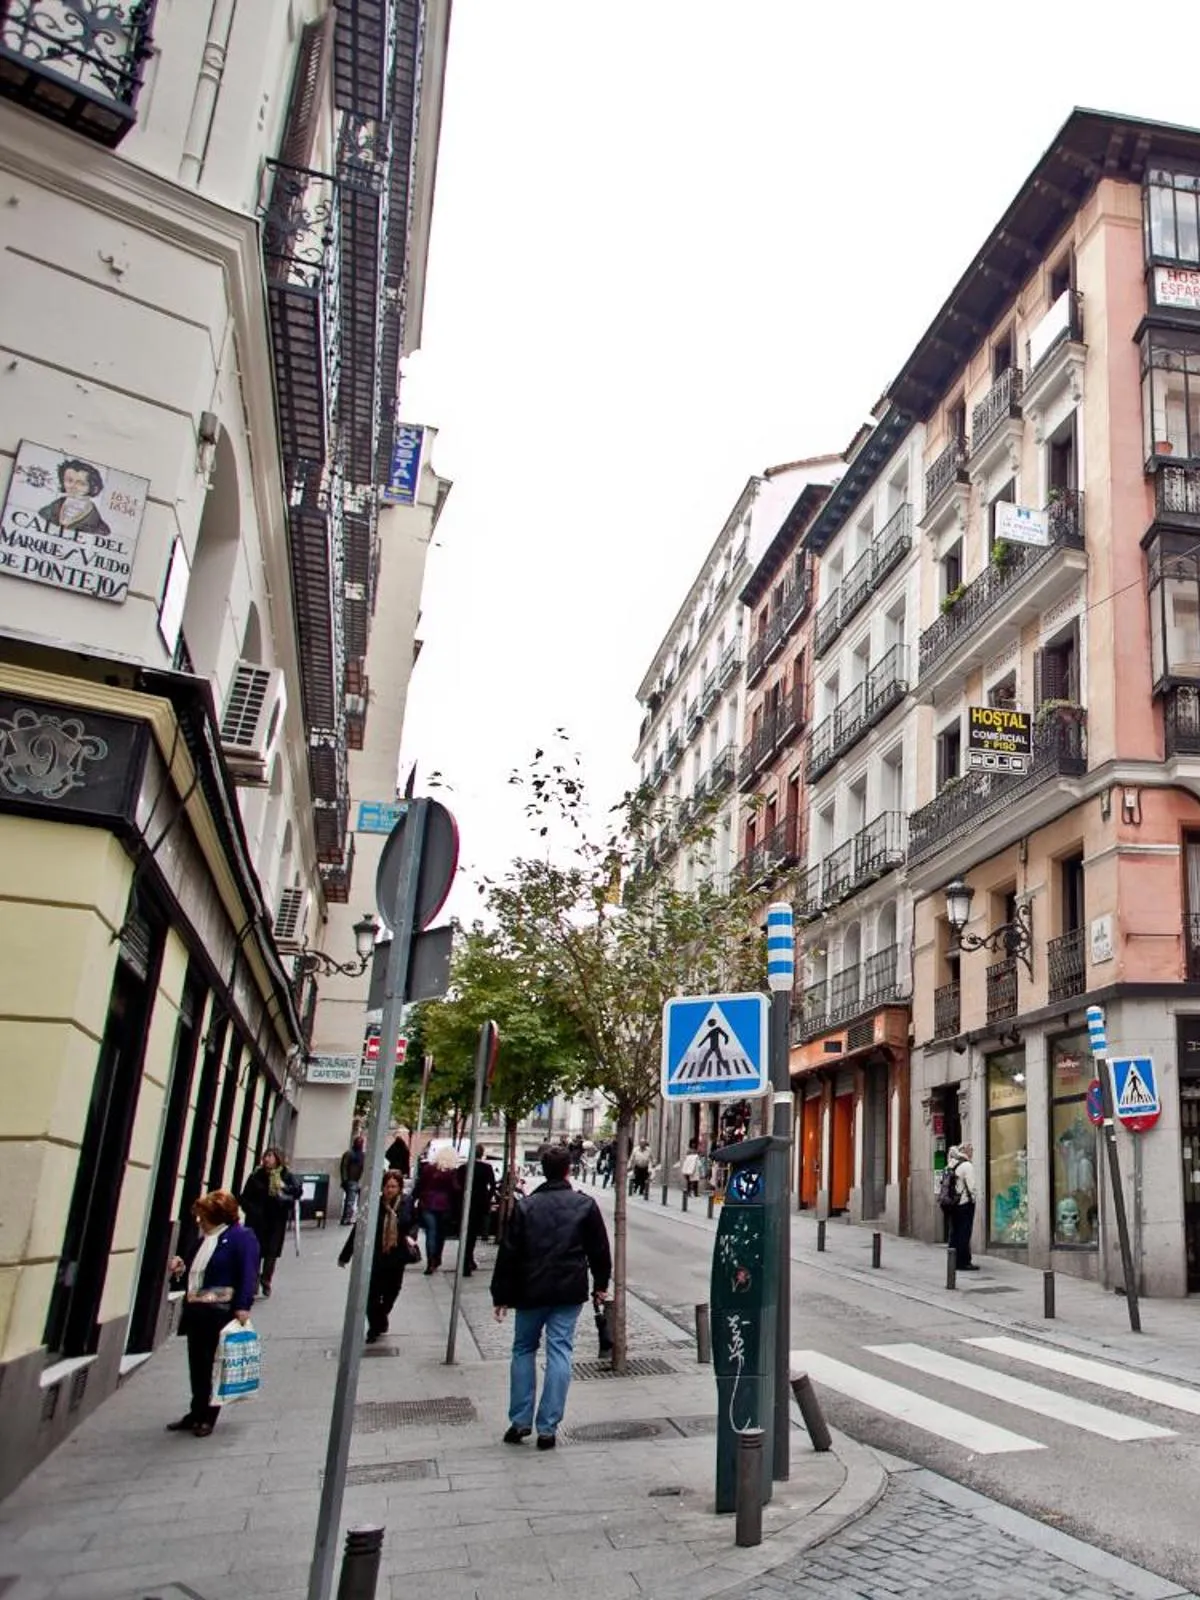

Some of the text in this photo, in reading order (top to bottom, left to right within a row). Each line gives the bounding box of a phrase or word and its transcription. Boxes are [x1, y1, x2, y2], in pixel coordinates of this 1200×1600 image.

[391, 428, 418, 489] HOSTAL
[11, 511, 128, 555] CALLE DEL
[80, 548, 130, 576] VIUDO
[22, 555, 128, 598] PONTEJOS
[972, 708, 1027, 729] HOSTAL
[972, 729, 1028, 745] COMERCIAL
[312, 1069, 351, 1080] CAFETERIA
